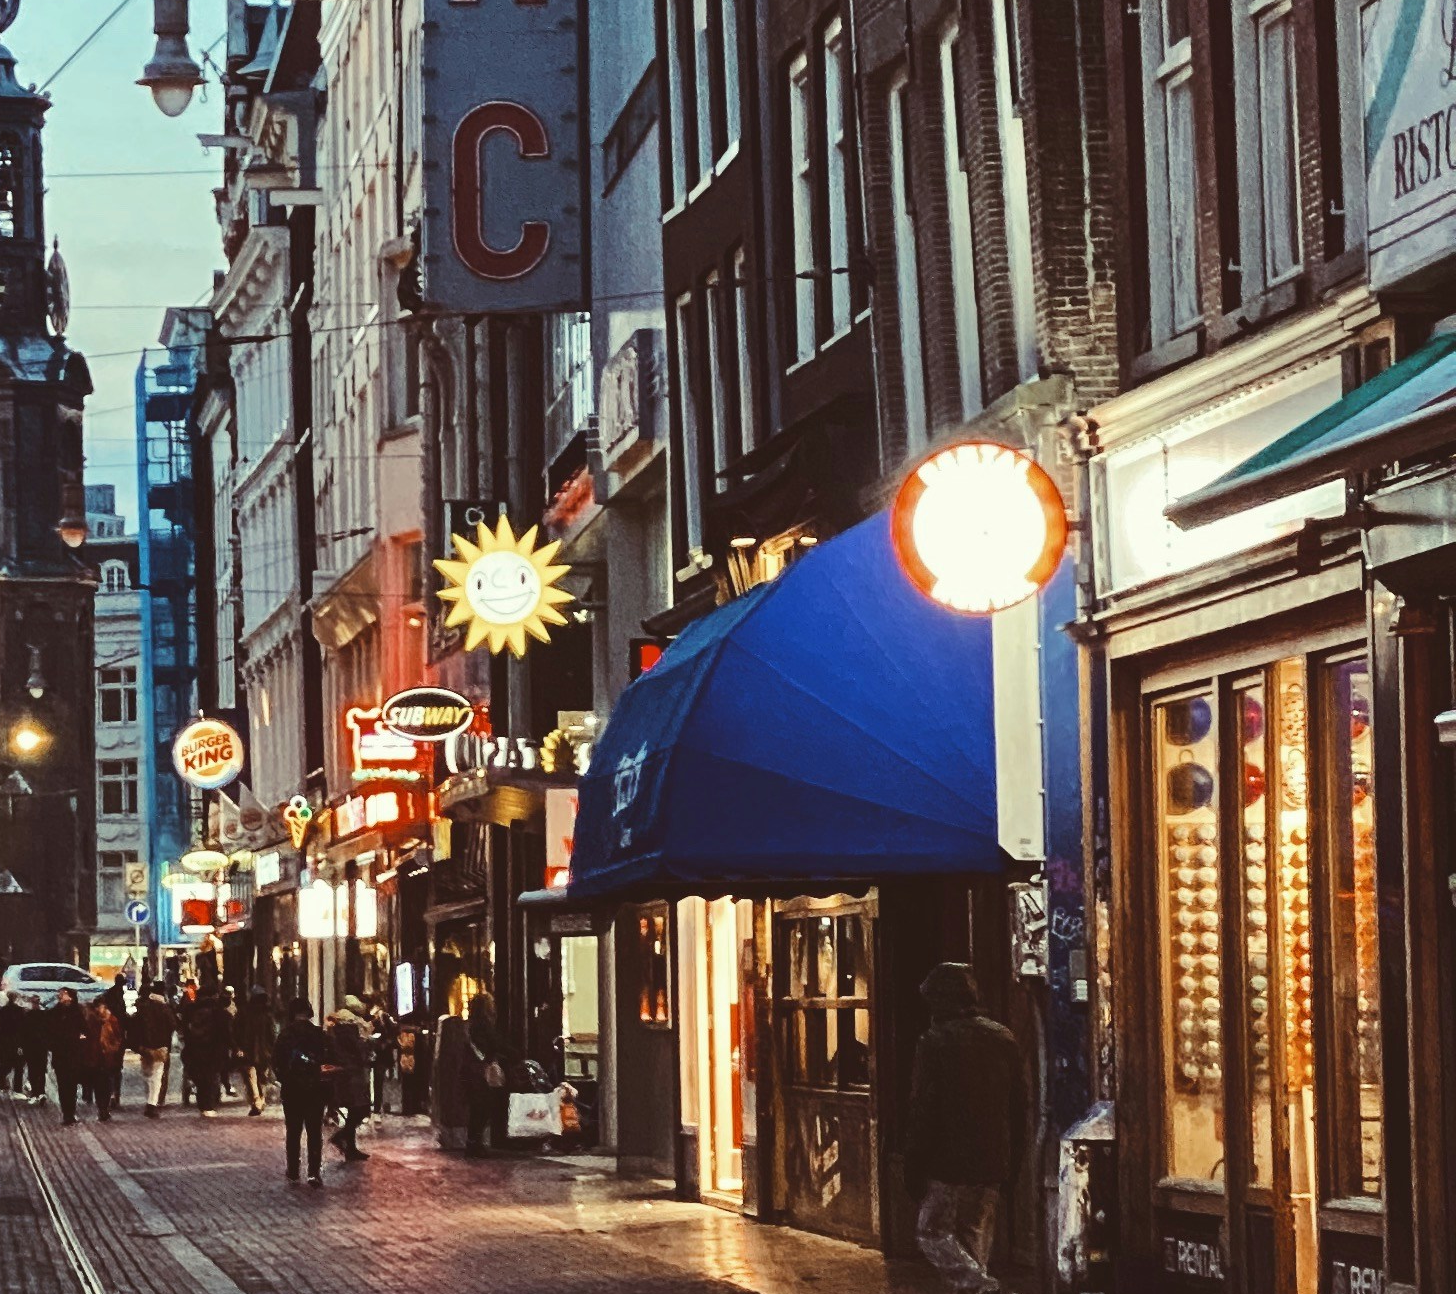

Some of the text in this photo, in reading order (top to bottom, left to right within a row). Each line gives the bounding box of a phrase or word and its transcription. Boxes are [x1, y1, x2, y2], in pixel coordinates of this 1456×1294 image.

[385, 705, 473, 728] SUBWAY
[181, 733, 231, 758] BURGER
[184, 745, 234, 774] KING
[1177, 1240, 1226, 1280] RENTAL
